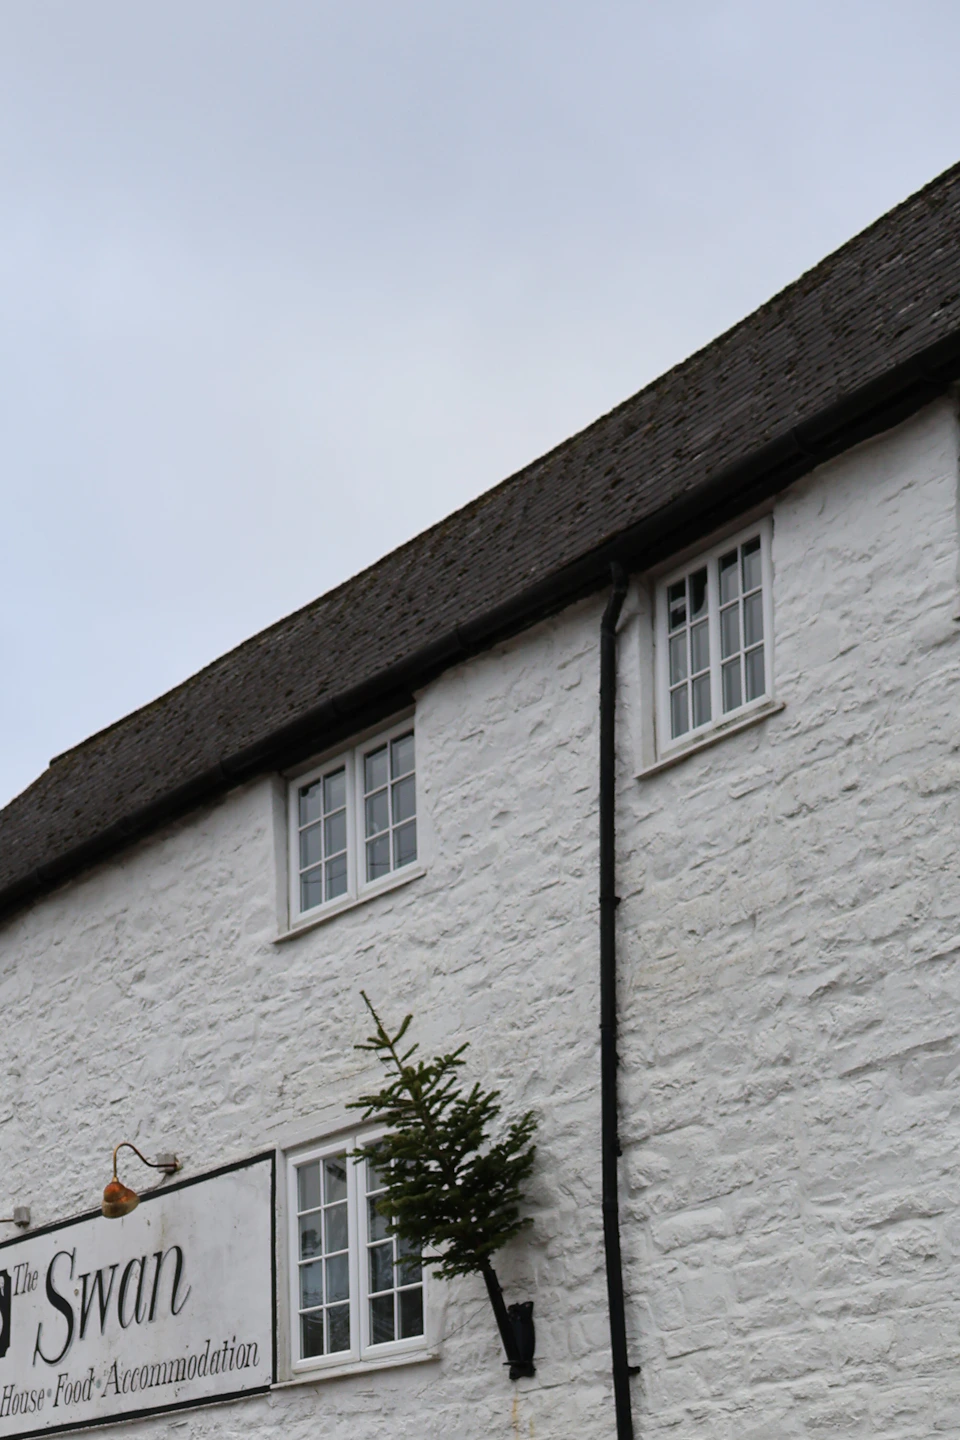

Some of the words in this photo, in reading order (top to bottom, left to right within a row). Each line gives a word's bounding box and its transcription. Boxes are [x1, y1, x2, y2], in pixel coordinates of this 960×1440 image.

[13, 1262, 39, 1296] The
[33, 1246, 192, 1366] Swan
[52, 1368, 95, 1407] Food
[101, 1335, 260, 1397] Accommodation
